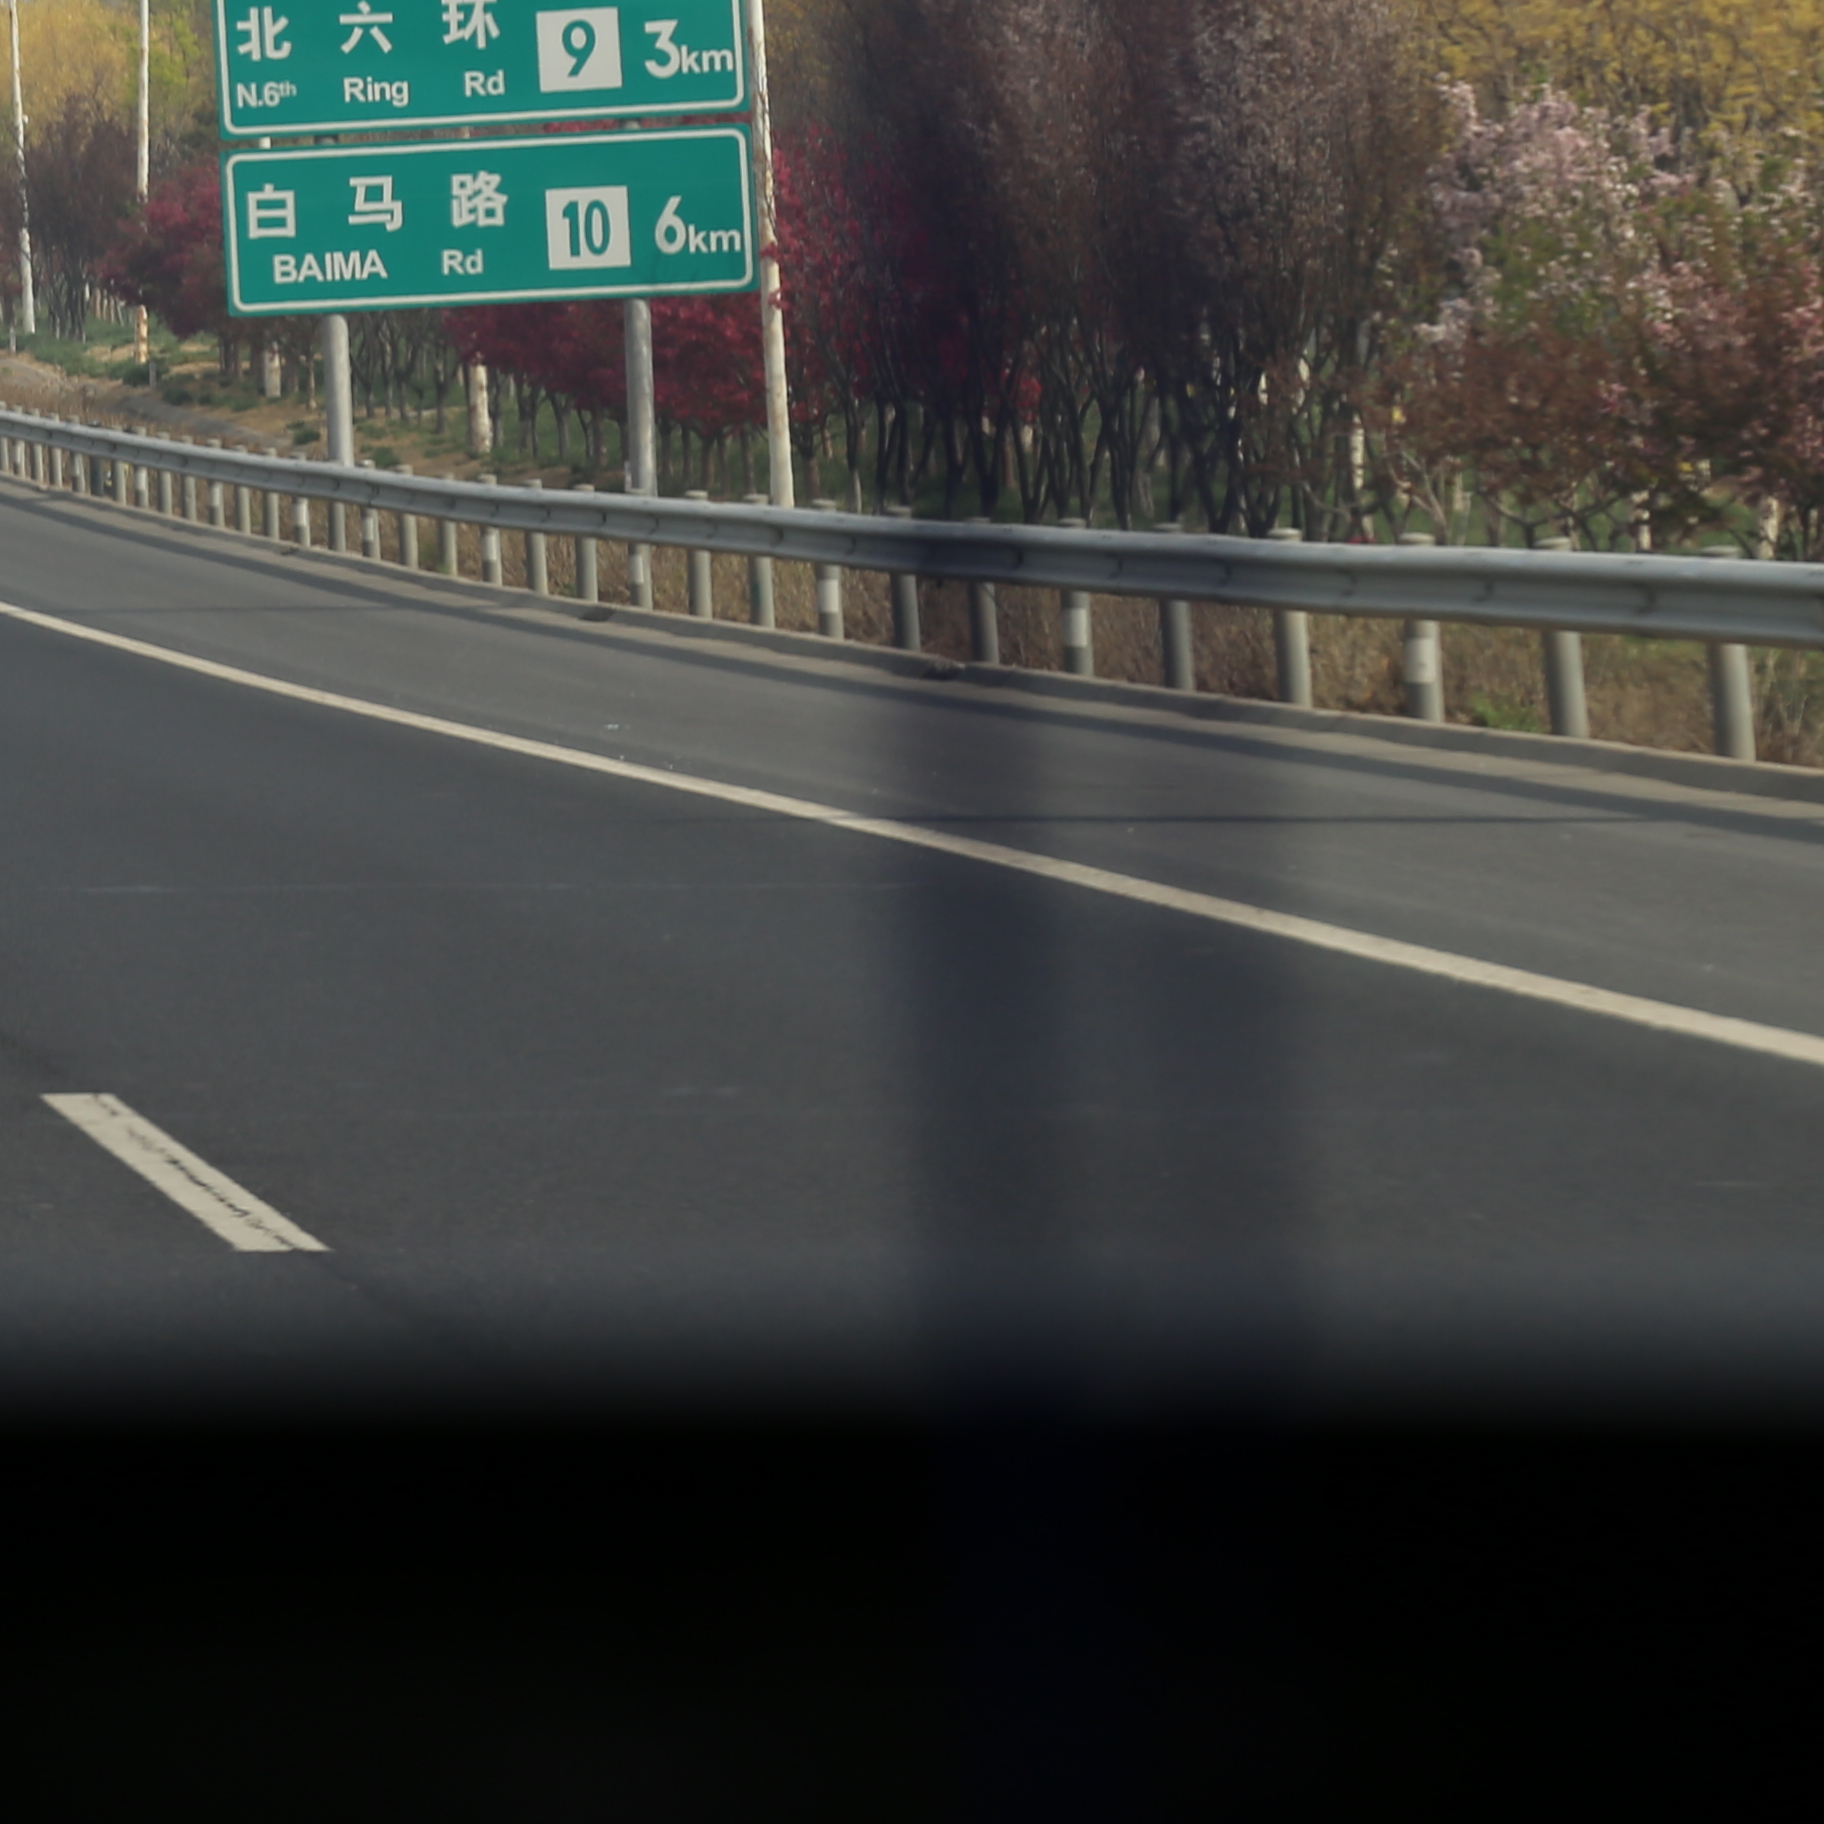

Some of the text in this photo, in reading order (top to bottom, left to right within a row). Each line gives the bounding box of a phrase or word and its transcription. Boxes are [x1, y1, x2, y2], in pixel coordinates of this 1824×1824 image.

[561, 19, 597, 78] 9
[644, 19, 735, 79] 3km
[236, 69, 506, 109] N.6th Ring Rd
[247, 171, 508, 239] 白马路
[561, 199, 612, 258] 10
[654, 195, 742, 255] 6km
[273, 249, 484, 284] BAIMA Rd
